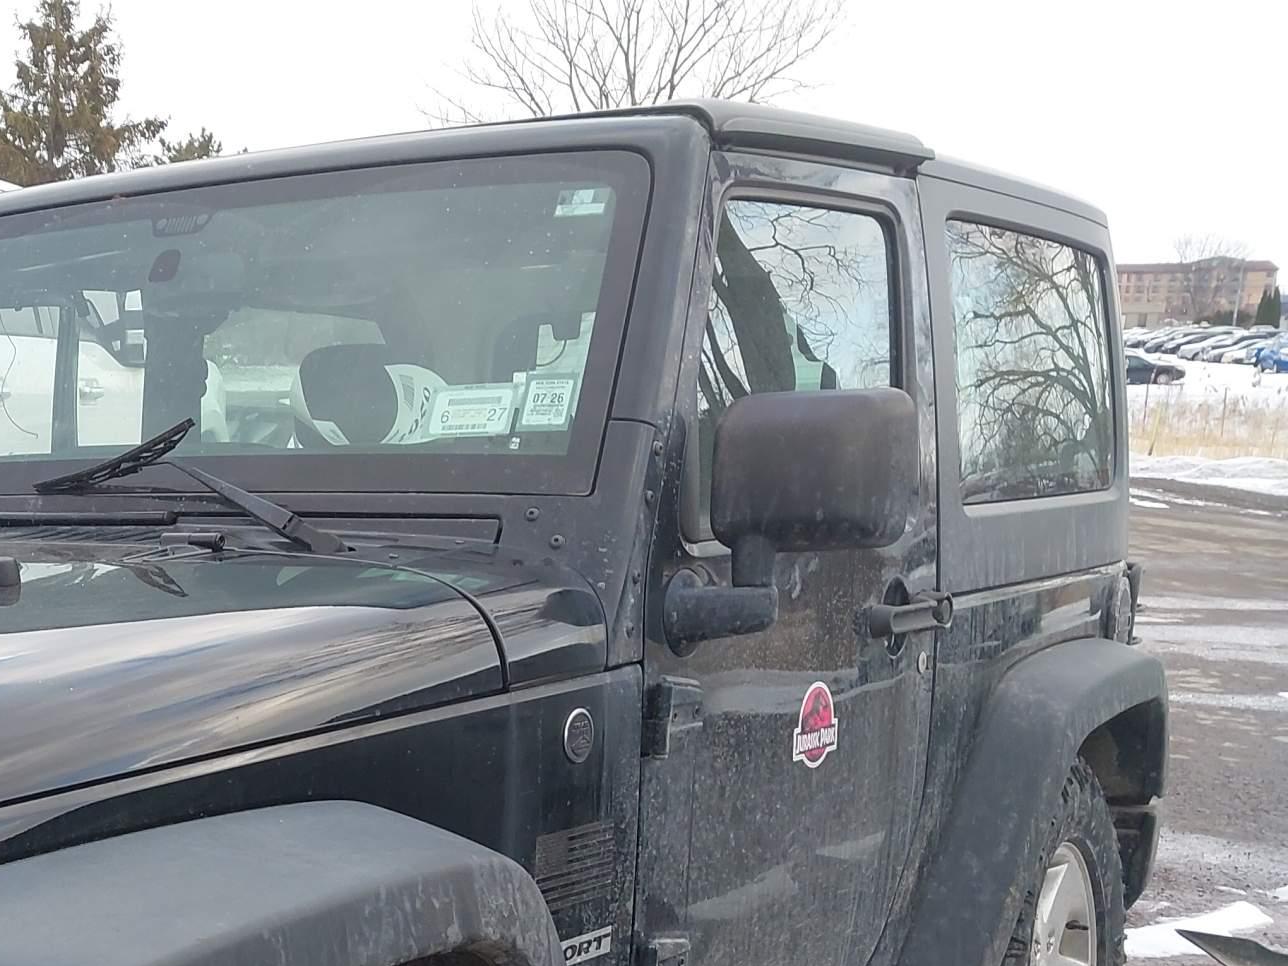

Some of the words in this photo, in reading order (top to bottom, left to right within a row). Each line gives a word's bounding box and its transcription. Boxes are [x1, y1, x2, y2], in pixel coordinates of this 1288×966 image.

[440, 410, 450, 423] 6
[486, 407, 508, 422] 27
[819, 727, 835, 748] PARK
[563, 933, 611, 961] ORT
